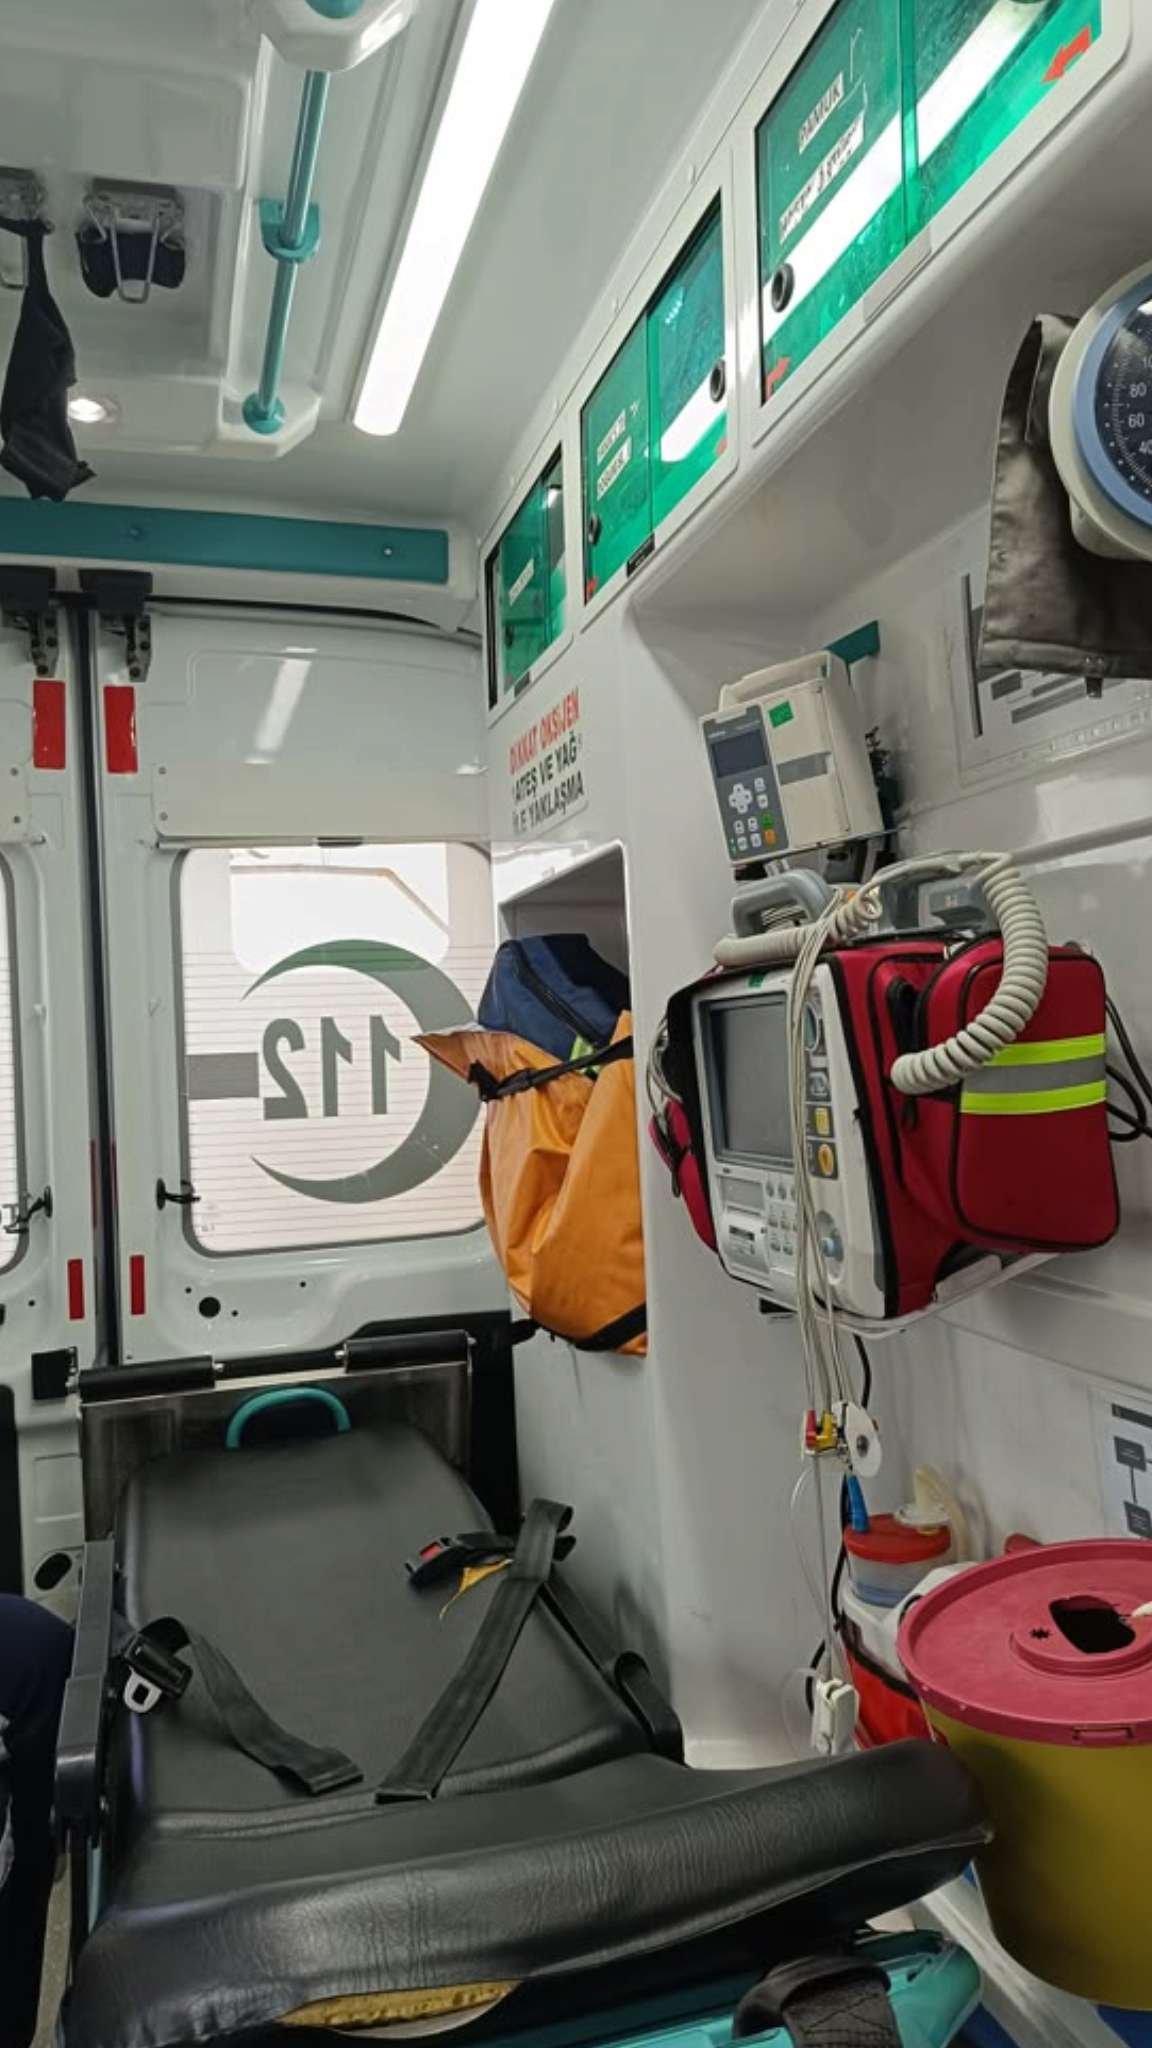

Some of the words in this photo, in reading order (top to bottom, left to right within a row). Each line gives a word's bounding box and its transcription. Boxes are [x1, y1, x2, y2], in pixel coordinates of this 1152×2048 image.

[1129, 382, 1147, 398] 80
[1128, 412, 1145, 428] 60
[539, 754, 553, 784] VE
[528, 770, 584, 827] YAKLAŞMA
